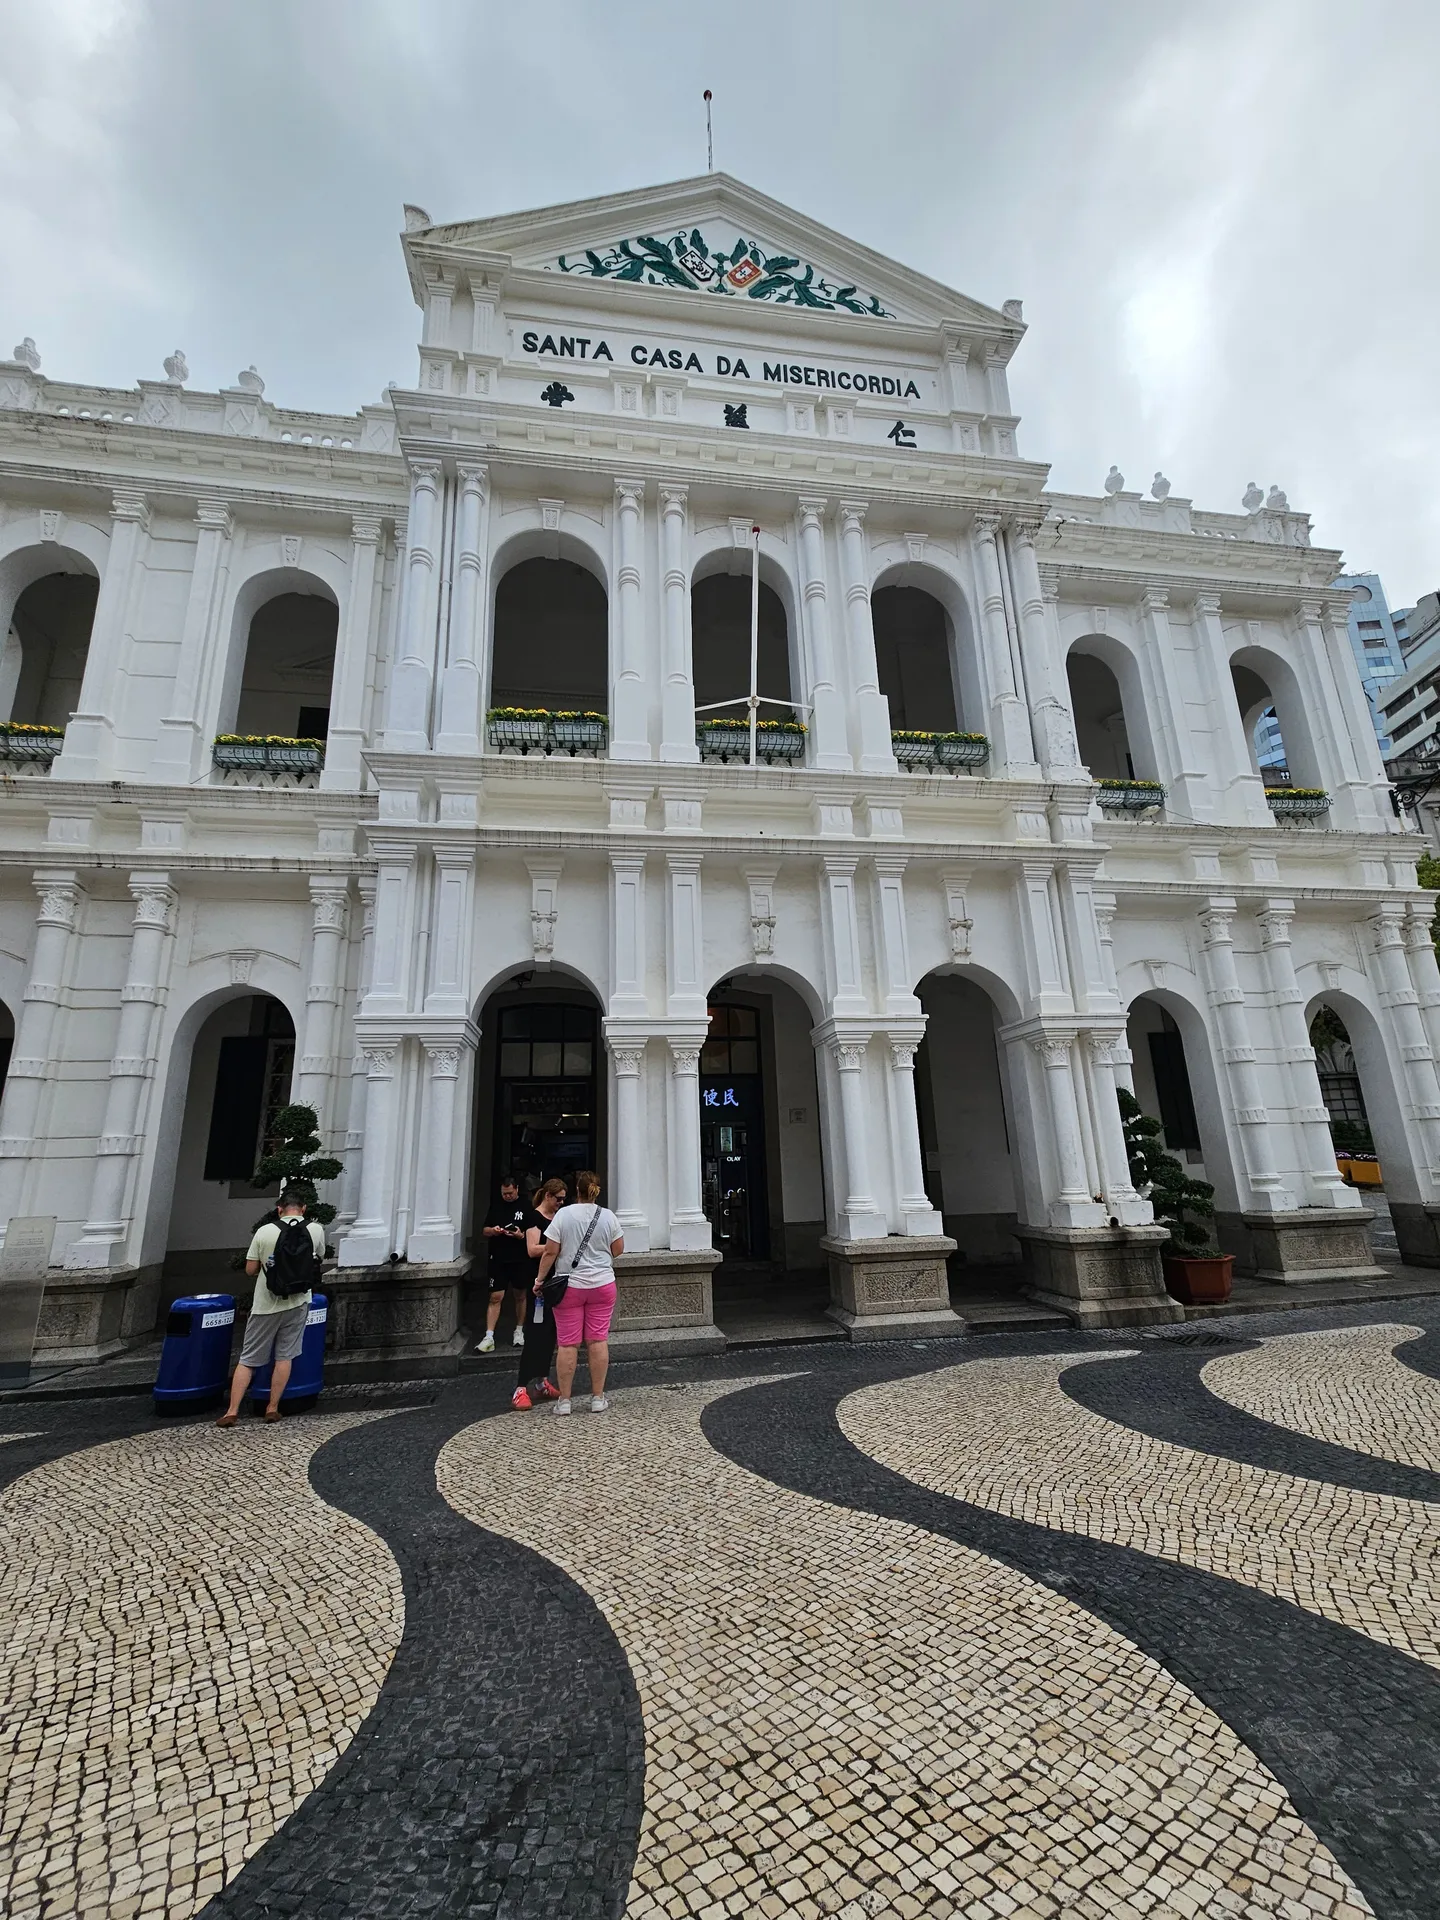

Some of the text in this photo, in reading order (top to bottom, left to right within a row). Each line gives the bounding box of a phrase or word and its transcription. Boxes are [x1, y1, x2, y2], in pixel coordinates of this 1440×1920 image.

[522, 332, 921, 399] SANTA CASA DA MISERICORDIA
[703, 1088, 739, 1106] 便民
